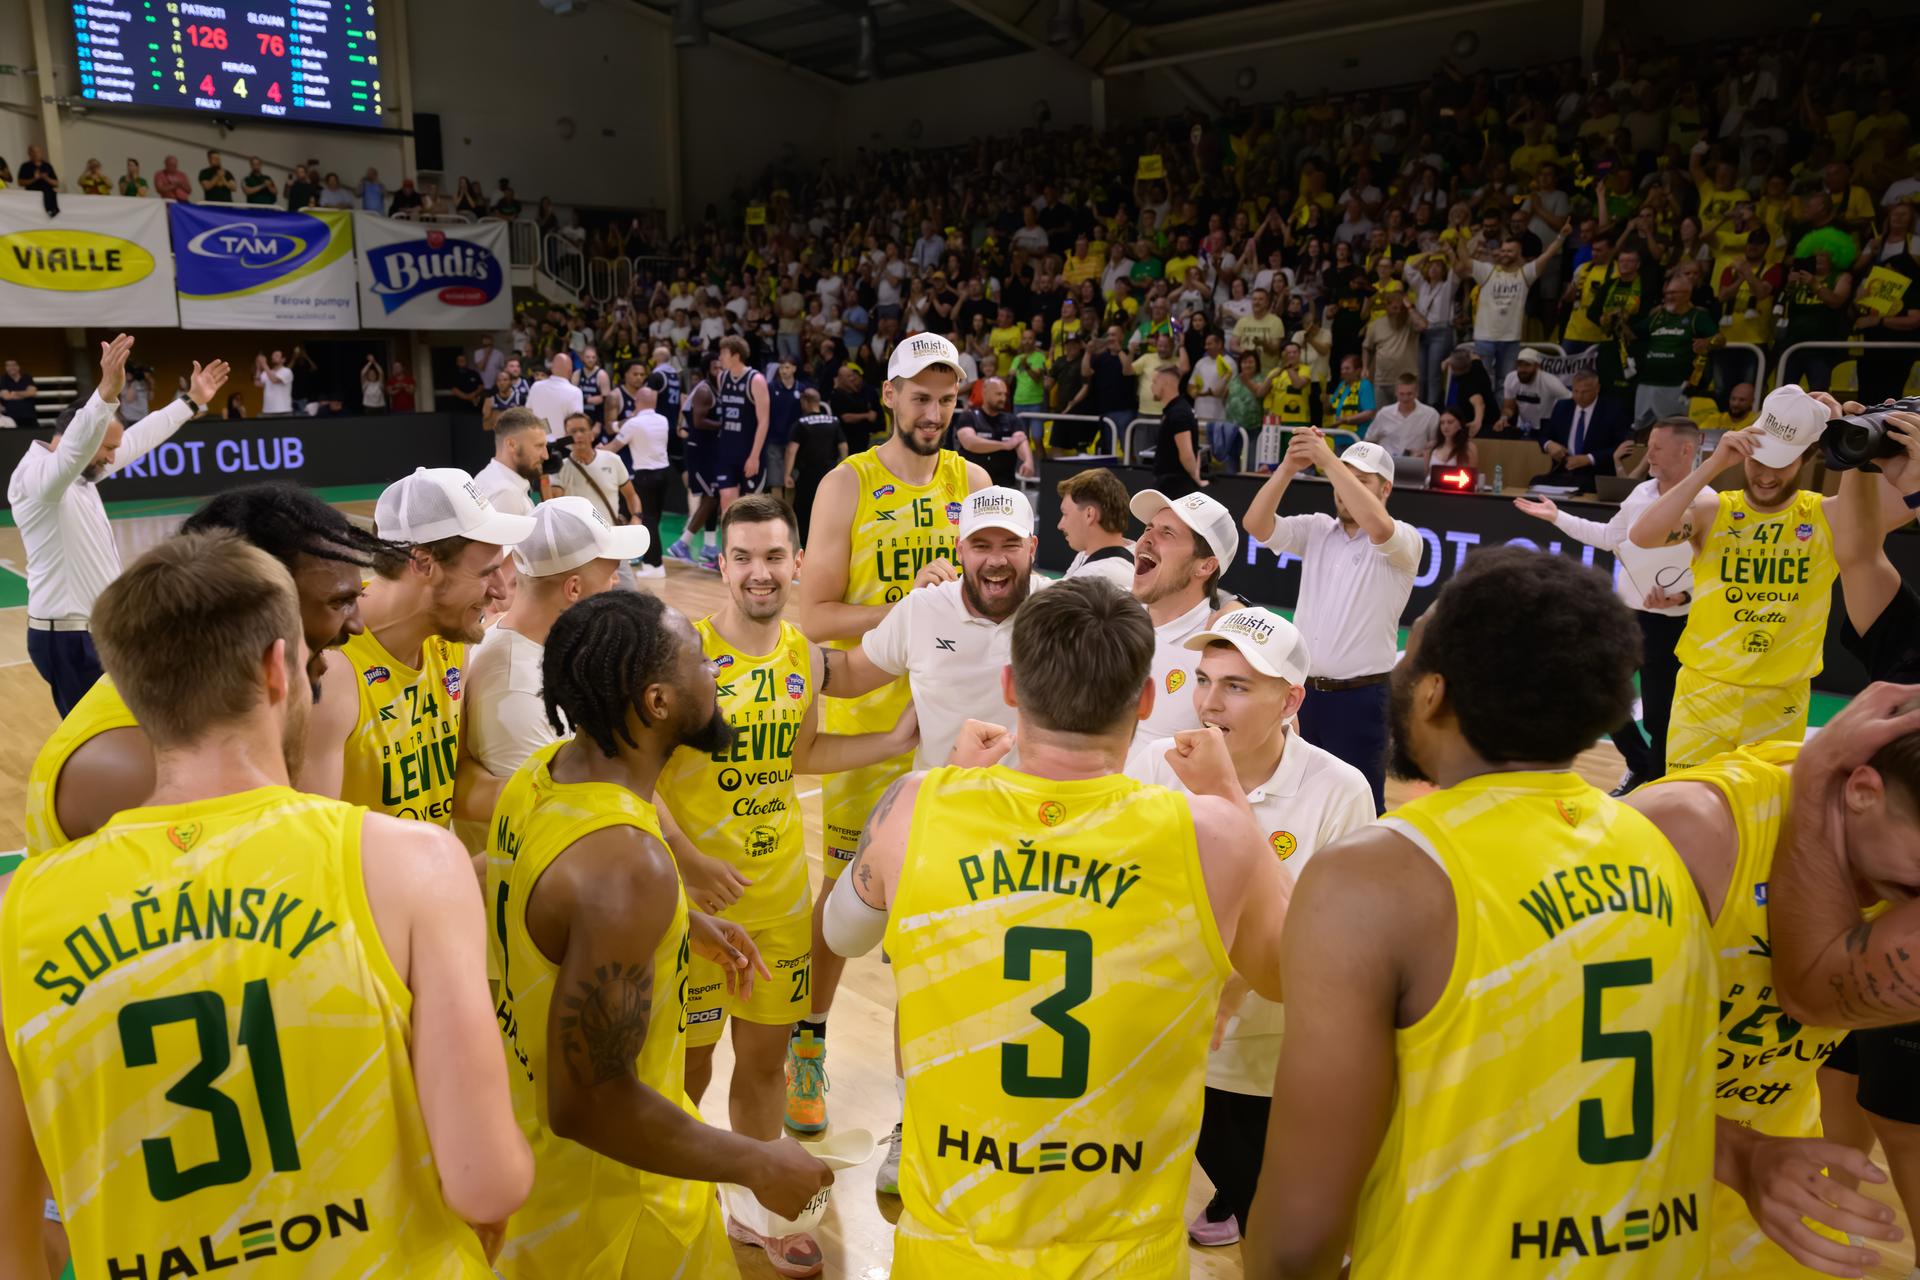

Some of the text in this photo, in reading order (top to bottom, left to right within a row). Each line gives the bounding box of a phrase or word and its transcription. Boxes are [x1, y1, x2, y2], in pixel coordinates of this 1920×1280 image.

[247, 12, 285, 28] SLOVAN
[186, 24, 229, 51] 126
[256, 33, 285, 57] 76
[199, 74, 283, 103] 4 4 4
[12, 245, 123, 273] VIALLE
[219, 236, 278, 256] TAM
[372, 246, 493, 295] Budiš
[315, 296, 351, 308] pumpy
[108, 437, 305, 479] RIOT CLUB
[912, 498, 934, 527] 15
[973, 494, 1014, 509] Majstri
[1753, 523, 1784, 545] 47
[1720, 556, 1811, 585] LEVICE
[1746, 592, 1800, 602] VEOLIA
[1223, 613, 1275, 637] Majstri
[1734, 608, 1787, 623] Cloetta
[751, 668, 776, 703] 21
[788, 684, 803, 694] SBL
[404, 685, 439, 727] 24
[382, 735, 459, 806] LEVIC
[733, 797, 787, 816] Cloetta
[831, 826, 861, 836] INTERSP
[837, 849, 857, 860] TIP
[959, 840, 1141, 909] PAŽICKÝ
[1519, 864, 1674, 939] WESSON
[34, 881, 336, 1006] SOLČÁNSKY
[688, 982, 723, 995] RSPORT
[790, 965, 810, 1003] 21
[1001, 926, 1093, 1099] 3
[1578, 958, 1654, 1165] 5
[118, 978, 301, 1202] 31
[938, 1125, 1143, 1174] HALEON
[1511, 1194, 1699, 1259] HALEON
